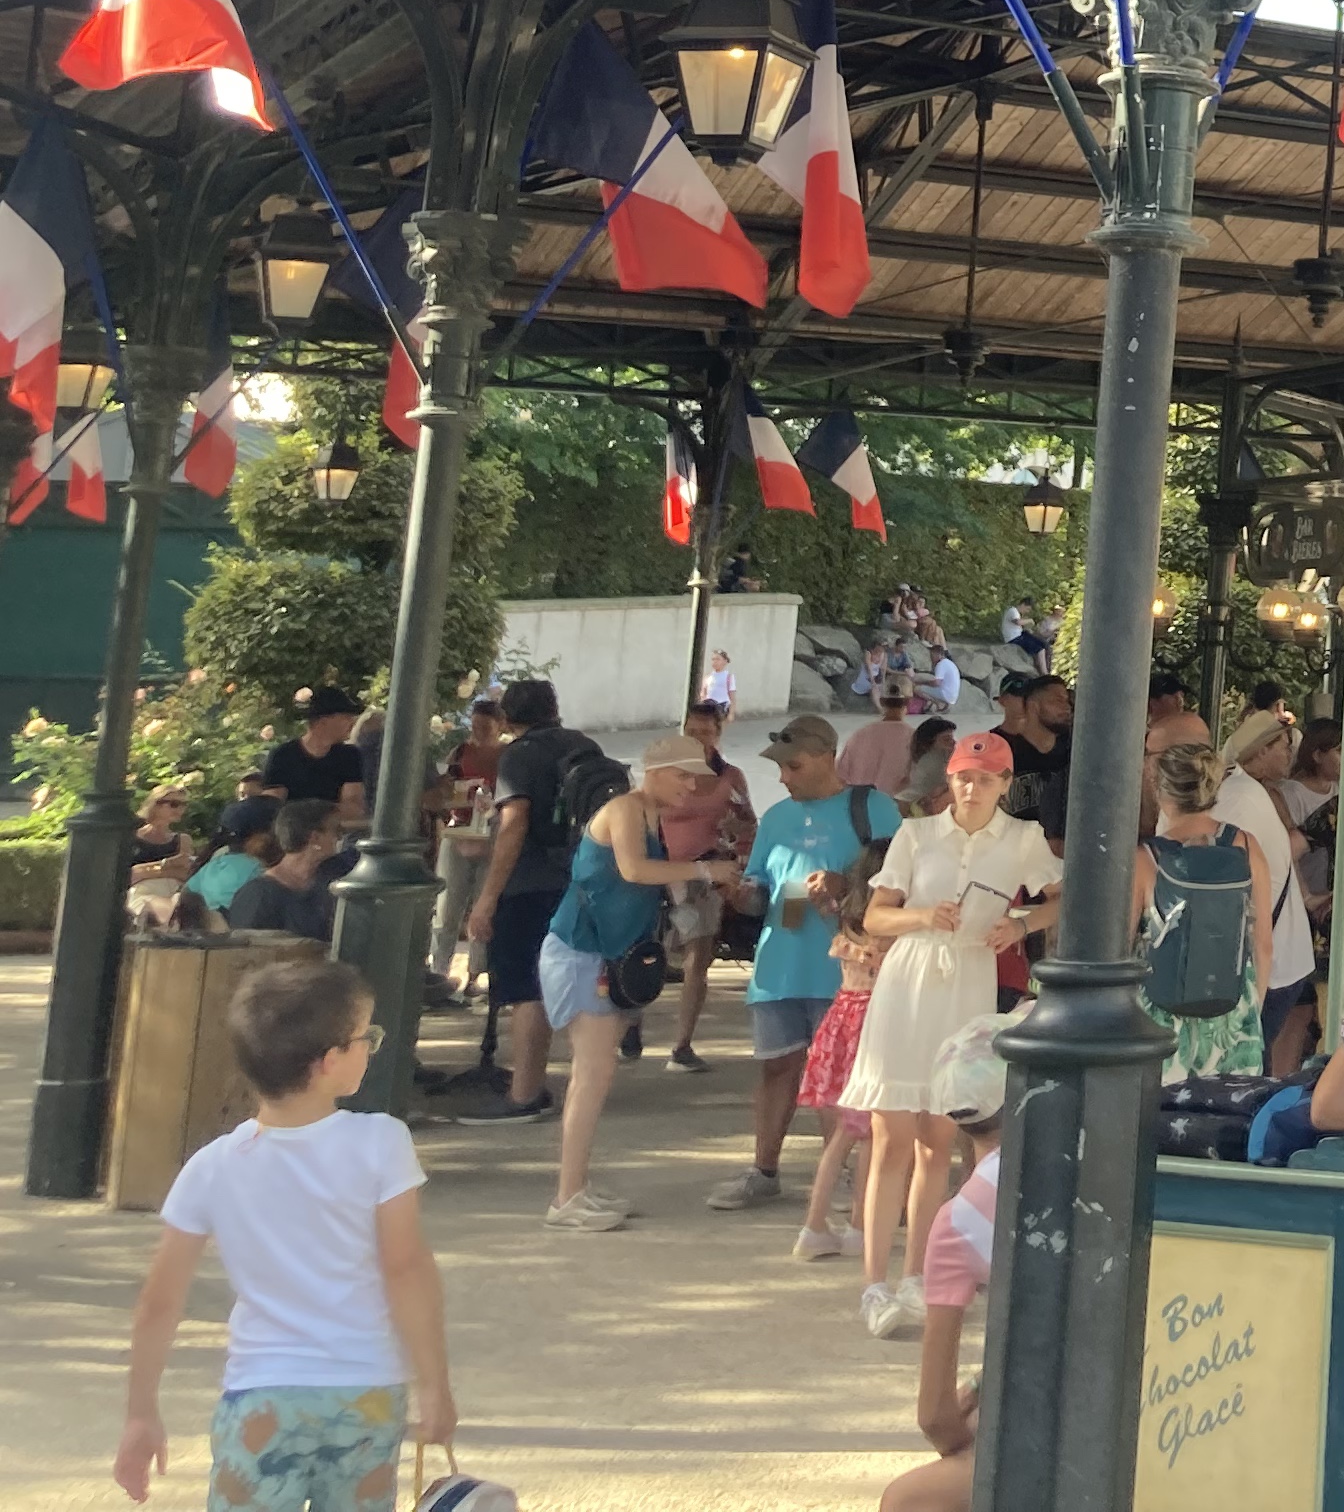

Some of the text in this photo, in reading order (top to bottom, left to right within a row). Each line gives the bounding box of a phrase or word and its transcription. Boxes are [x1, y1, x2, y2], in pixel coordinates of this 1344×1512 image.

[1162, 1293, 1224, 1343] Bon
[1141, 1320, 1256, 1414] hocolat
[1158, 1383, 1246, 1470] Glacé
